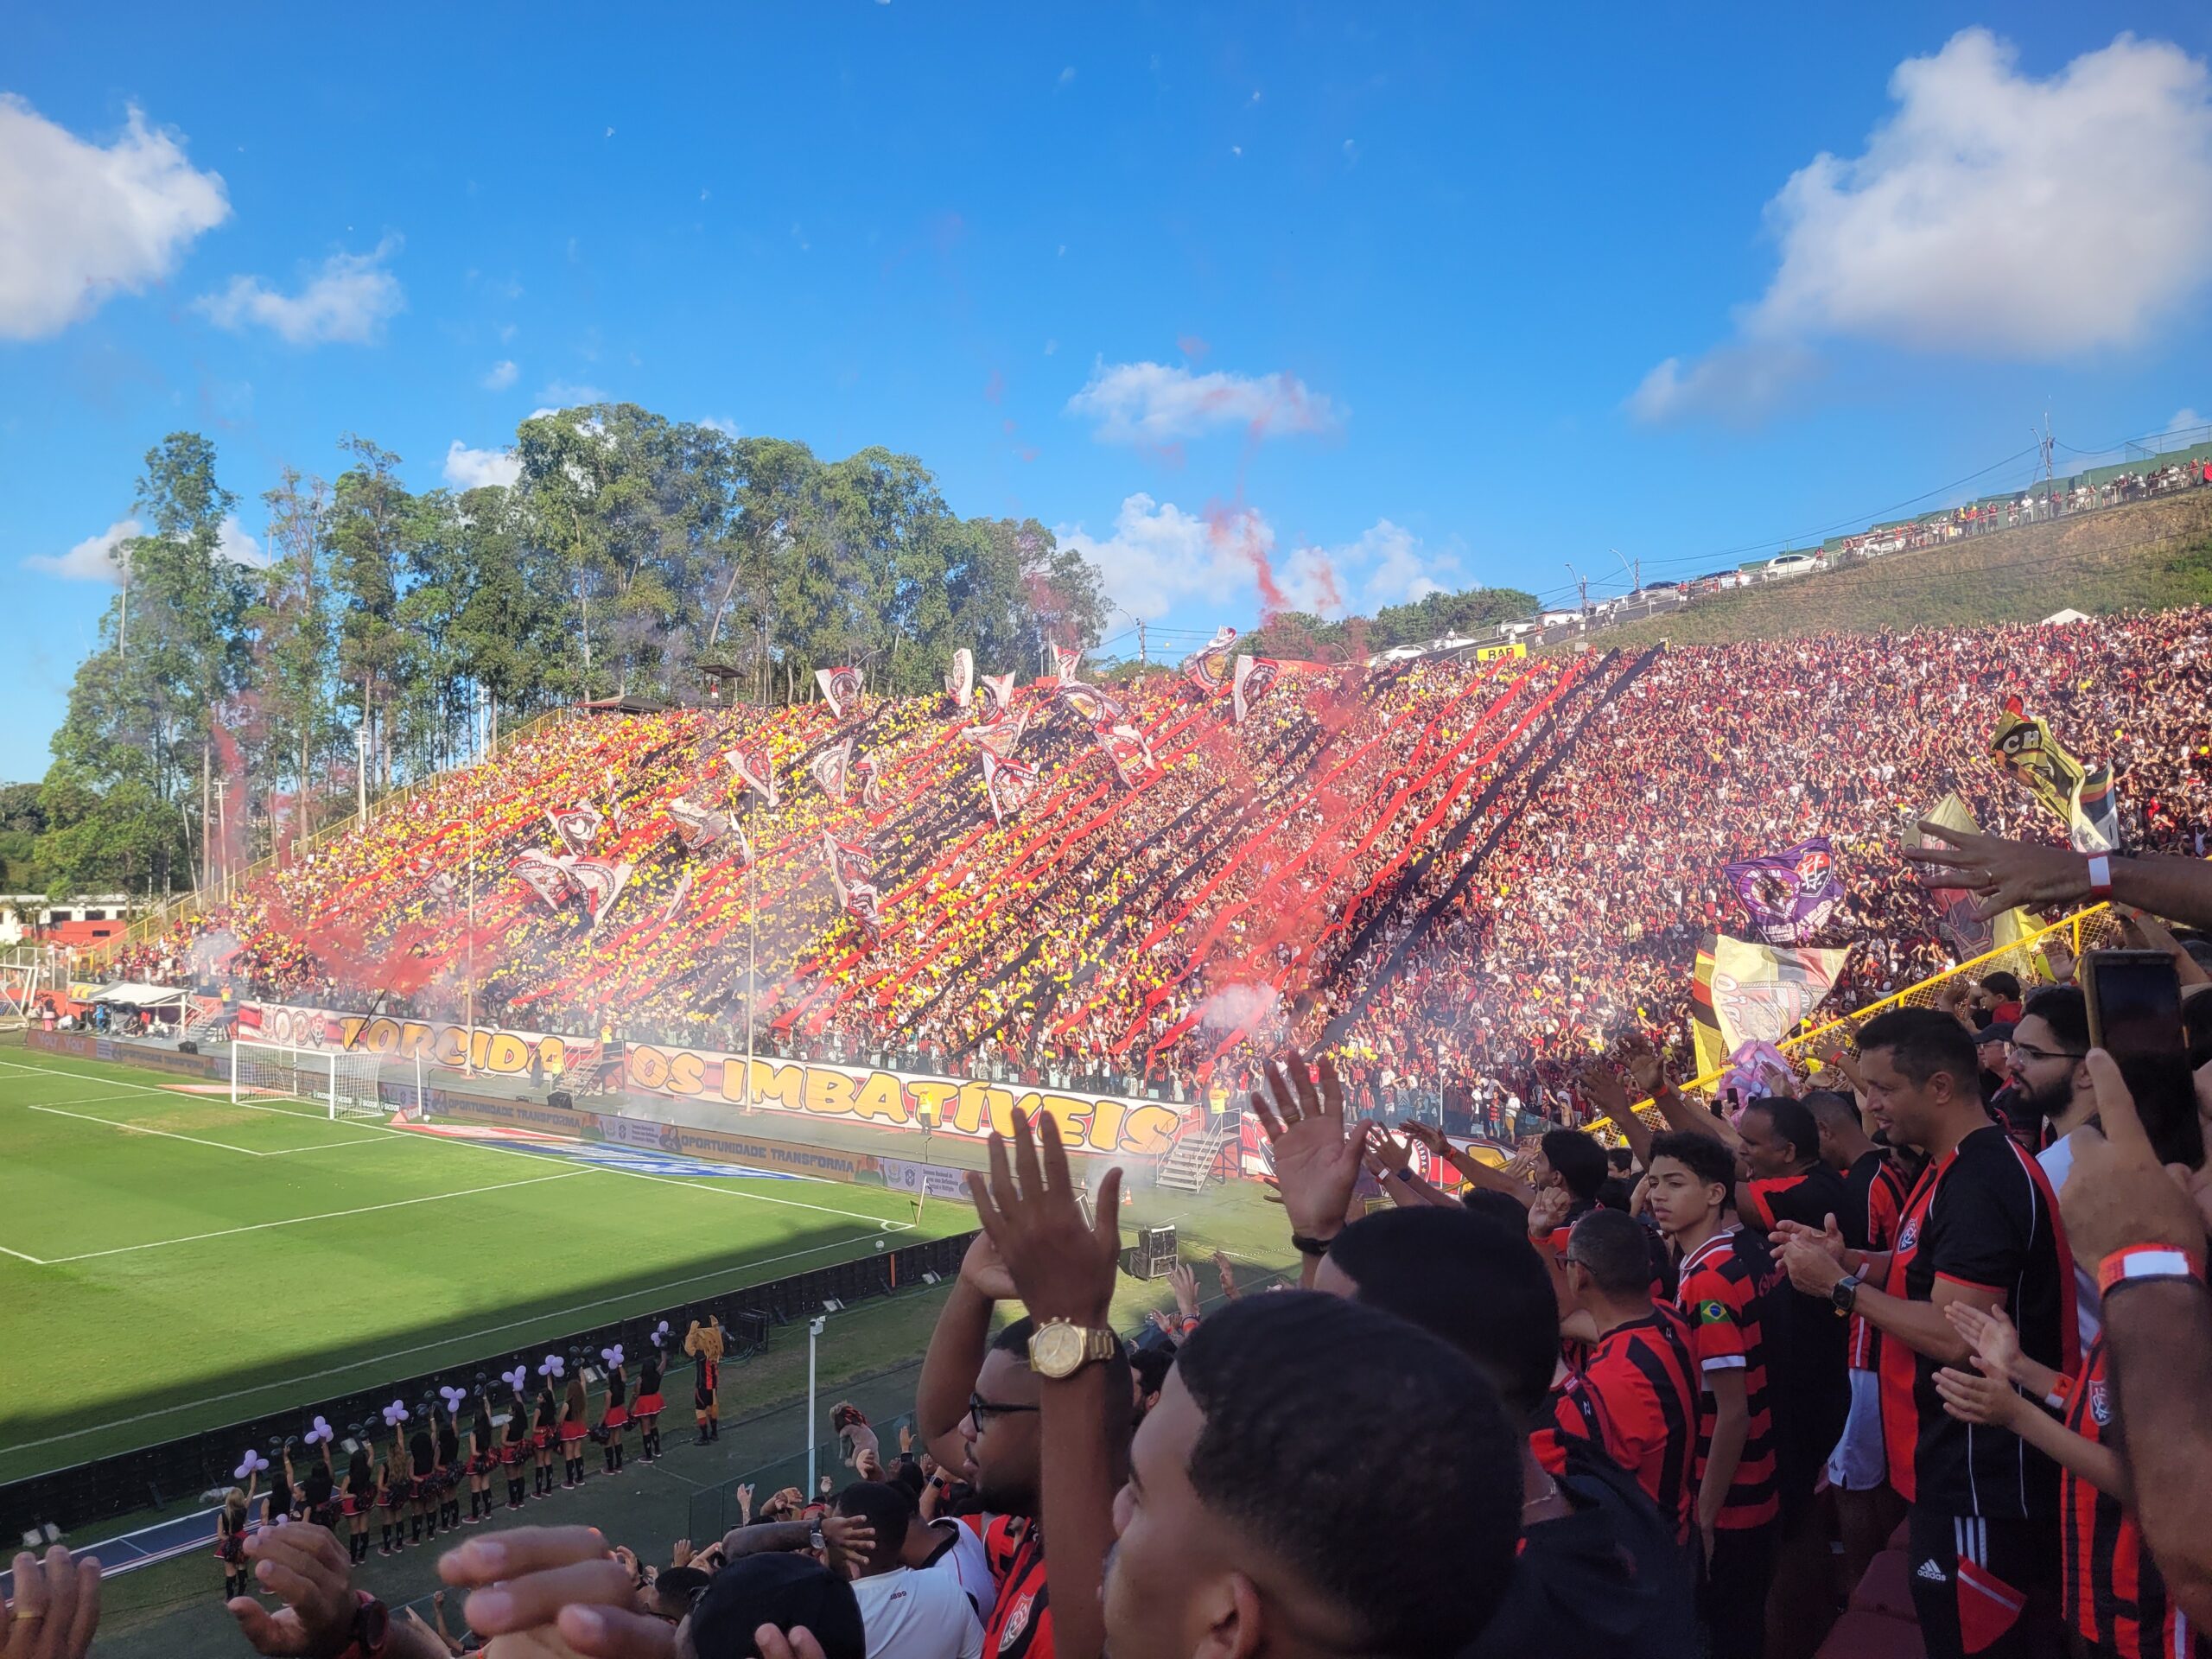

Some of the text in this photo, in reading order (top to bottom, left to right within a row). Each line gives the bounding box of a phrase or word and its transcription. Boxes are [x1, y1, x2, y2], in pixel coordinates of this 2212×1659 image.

[2003, 730, 2039, 754] CH
[995, 768, 1007, 797] TOCIDA
[1764, 922, 1795, 935] LUGAR
[339, 1016, 568, 1074] TORCIDA
[631, 1045, 706, 1095] OS
[385, 1103, 400, 1112] SICOOB
[448, 1098, 514, 1117] OPORTUNIDADE
[517, 1109, 581, 1128] TRANSFORMA
[681, 1134, 766, 1159] OPORTUNIDADE
[771, 1147, 855, 1173] TRANSFORMA
[1917, 1569, 1946, 1581] adidas
